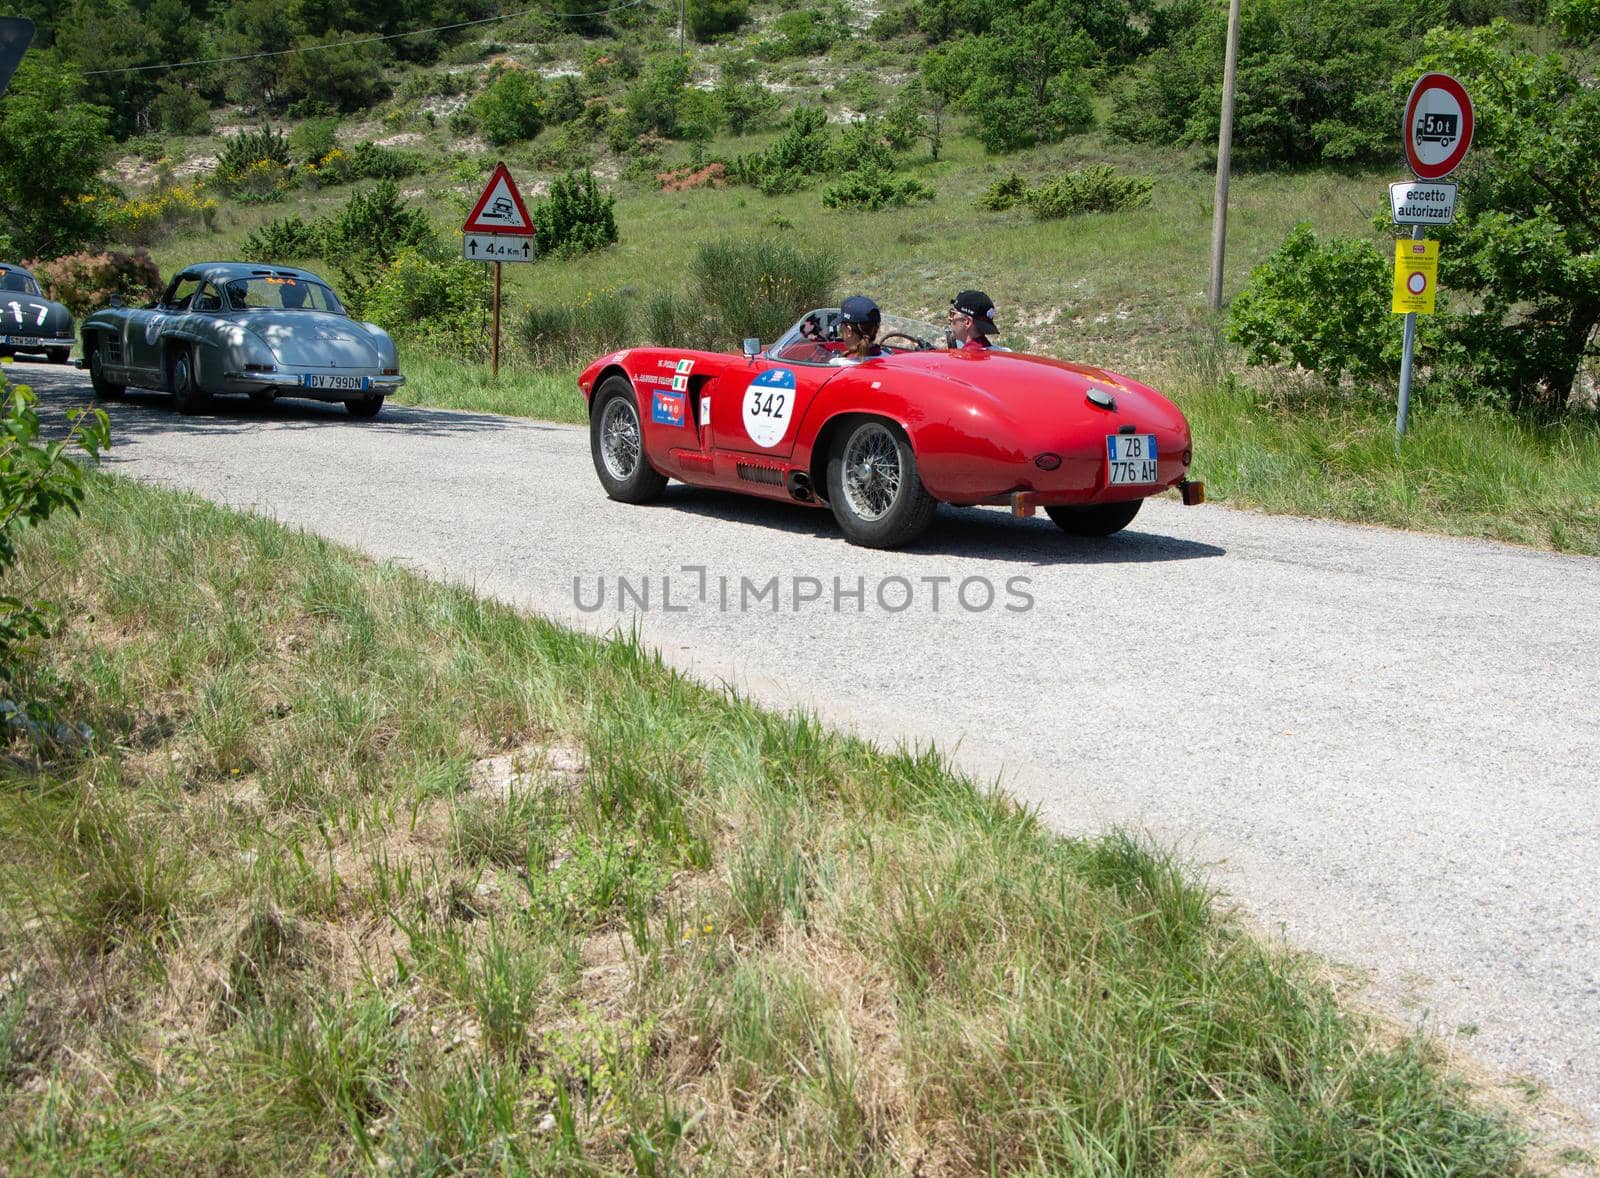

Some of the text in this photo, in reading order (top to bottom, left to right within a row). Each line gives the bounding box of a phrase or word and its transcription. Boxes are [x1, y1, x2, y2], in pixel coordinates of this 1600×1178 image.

[1445, 121, 1450, 133] t
[1406, 189, 1446, 202] eccetto
[1398, 204, 1451, 218] autorizzati
[311, 375, 361, 389] DV 799DN
[751, 392, 785, 418] 342
[1125, 438, 1141, 458] ZB
[1111, 461, 1156, 482] 776 AH
